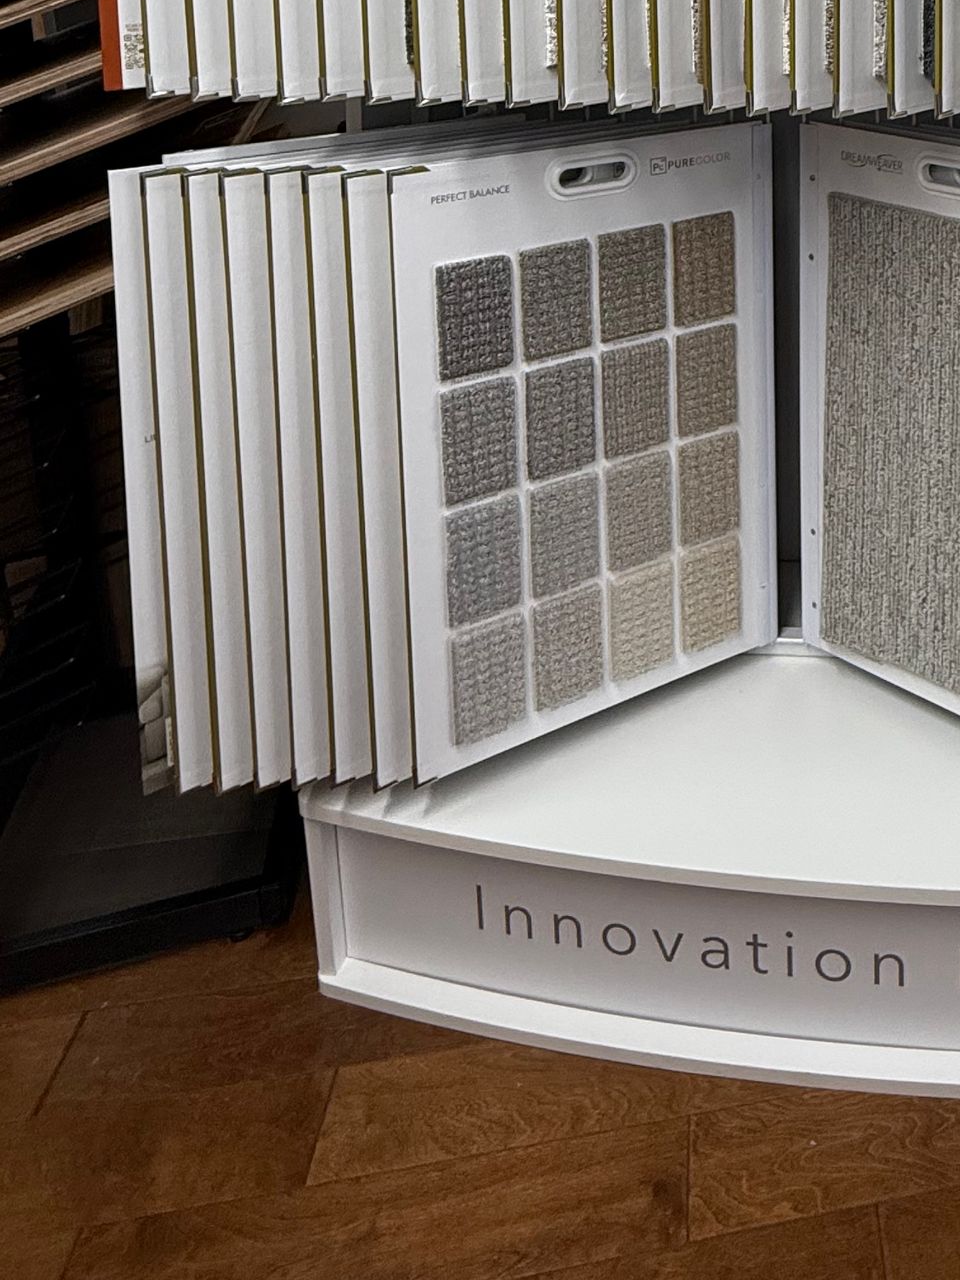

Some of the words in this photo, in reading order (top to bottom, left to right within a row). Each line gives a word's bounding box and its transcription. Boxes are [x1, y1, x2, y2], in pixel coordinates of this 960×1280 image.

[667, 152, 731, 170] PURECOLOR
[431, 191, 467, 205] PERFECT
[469, 185, 511, 199] BALANCE
[475, 883, 906, 987] Innovation
